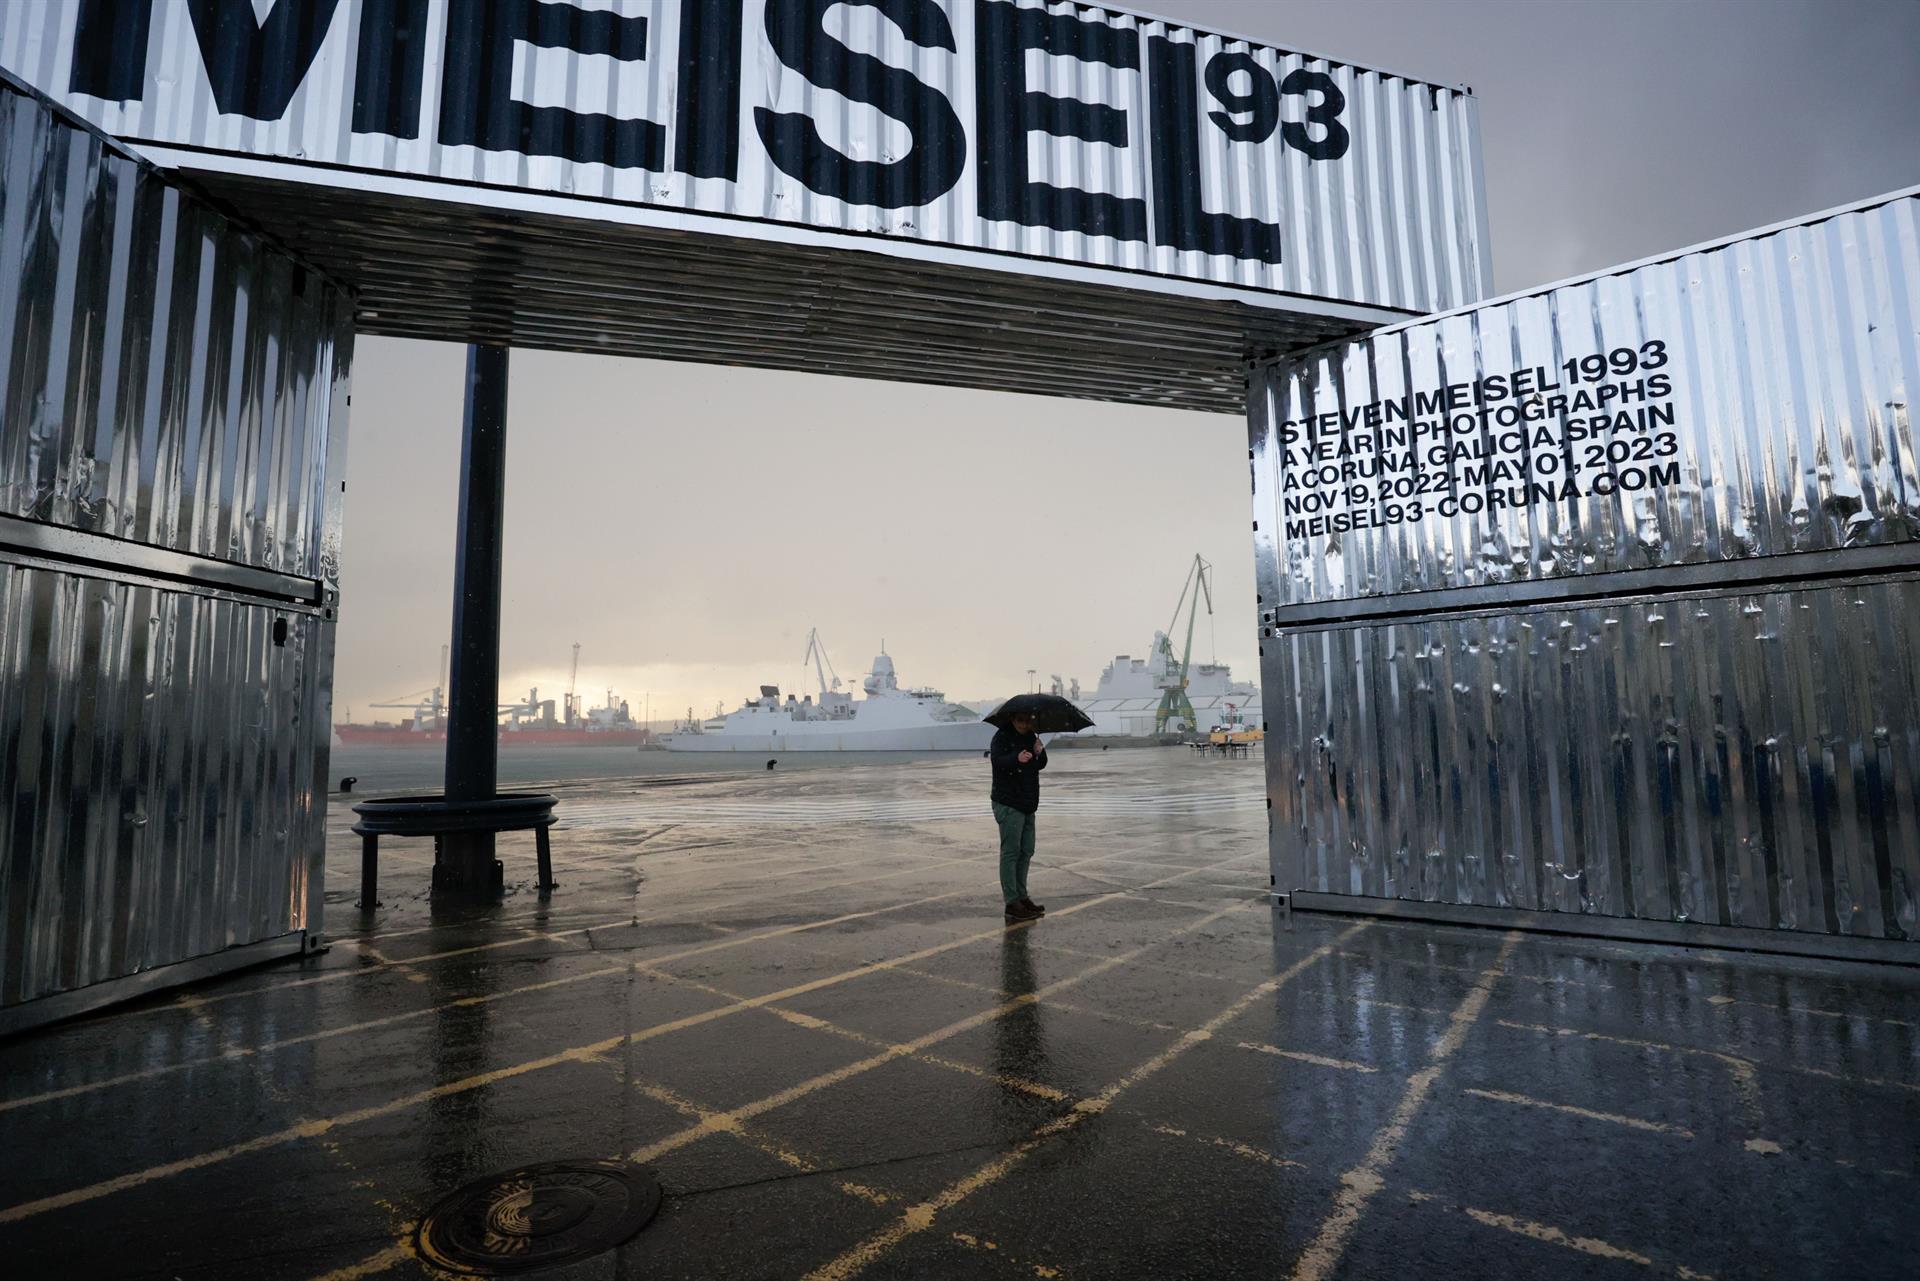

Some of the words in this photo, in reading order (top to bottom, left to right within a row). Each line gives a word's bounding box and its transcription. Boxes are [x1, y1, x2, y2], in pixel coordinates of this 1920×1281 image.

[1279, 396, 1410, 445] STEVEN
[1415, 366, 1561, 416] MEISEL
[1562, 339, 1669, 385] 1993
[1282, 449, 1299, 469] A
[1301, 434, 1373, 465] YEAR
[1377, 427, 1406, 450] IN
[1411, 373, 1673, 444] PHOTOGRAPHS
[1283, 472, 1301, 493] A
[1565, 402, 1675, 443] SPAIN
[1284, 489, 1338, 516] NOV
[1583, 432, 1679, 468] 2023
[1285, 461, 1681, 541] MEISEL93-CORUNA.COM
